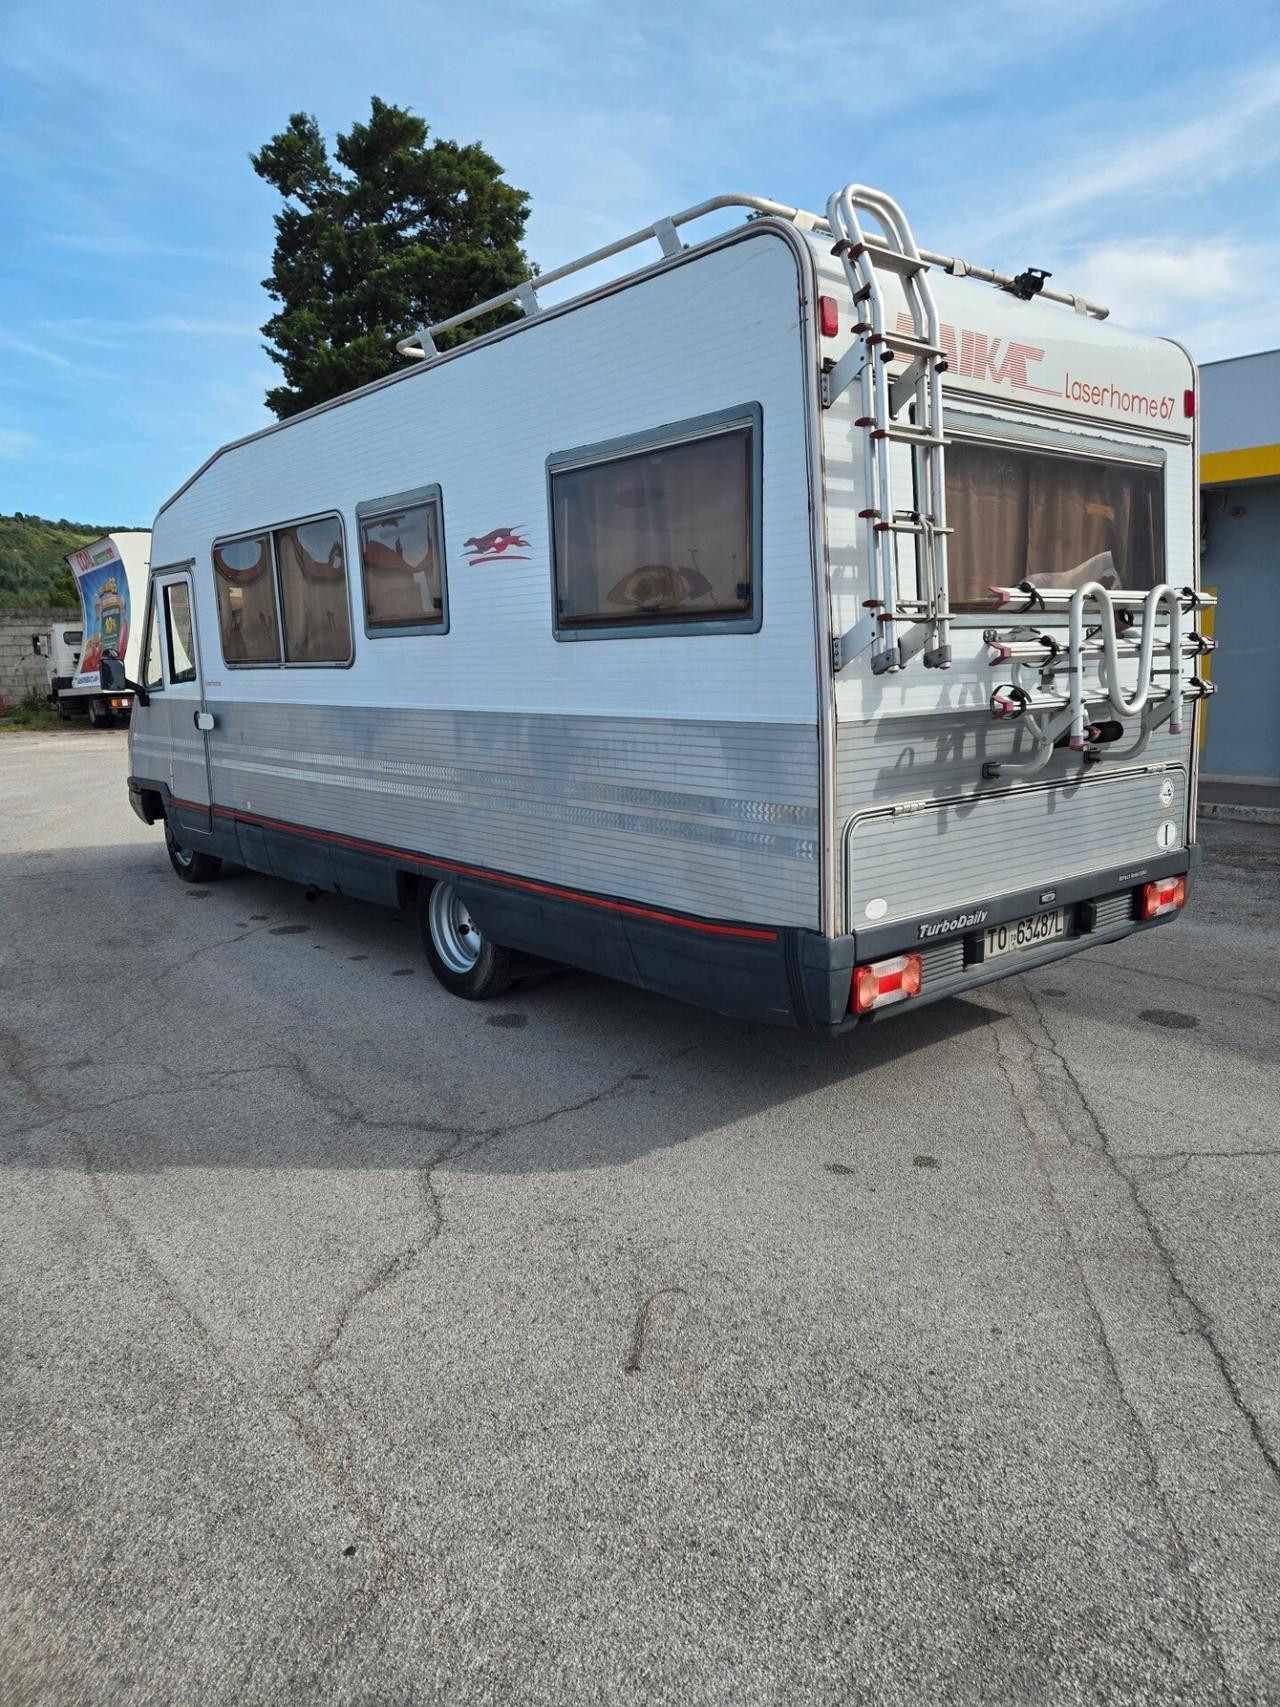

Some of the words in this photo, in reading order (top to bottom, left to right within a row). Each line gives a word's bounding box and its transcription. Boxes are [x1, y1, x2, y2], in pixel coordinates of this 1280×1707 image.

[918, 910, 989, 939] TurboDaily
[987, 925, 1007, 953] TO
[1016, 909, 1063, 945] 63487L
